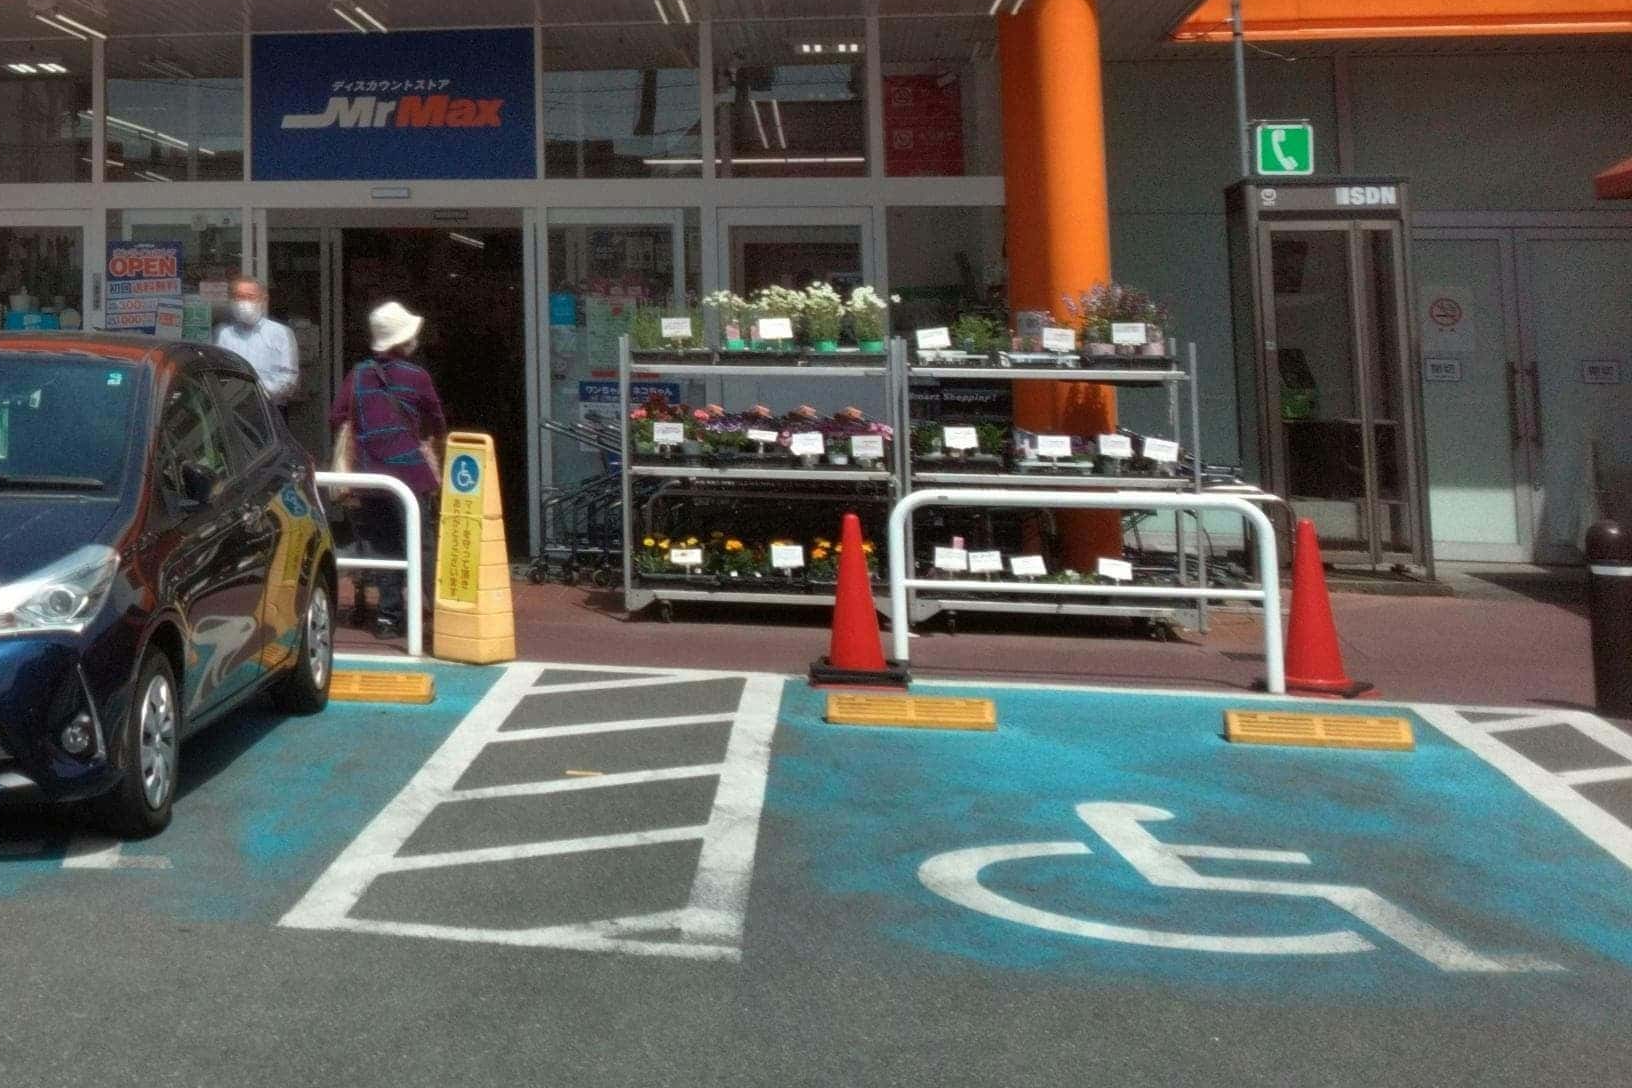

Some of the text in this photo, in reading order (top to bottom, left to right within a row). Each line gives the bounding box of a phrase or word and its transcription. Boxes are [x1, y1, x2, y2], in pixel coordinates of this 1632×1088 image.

[332, 79, 451, 93] ディスカウントストア
[280, 94, 505, 129] MrMax
[109, 255, 177, 277] OPEN
